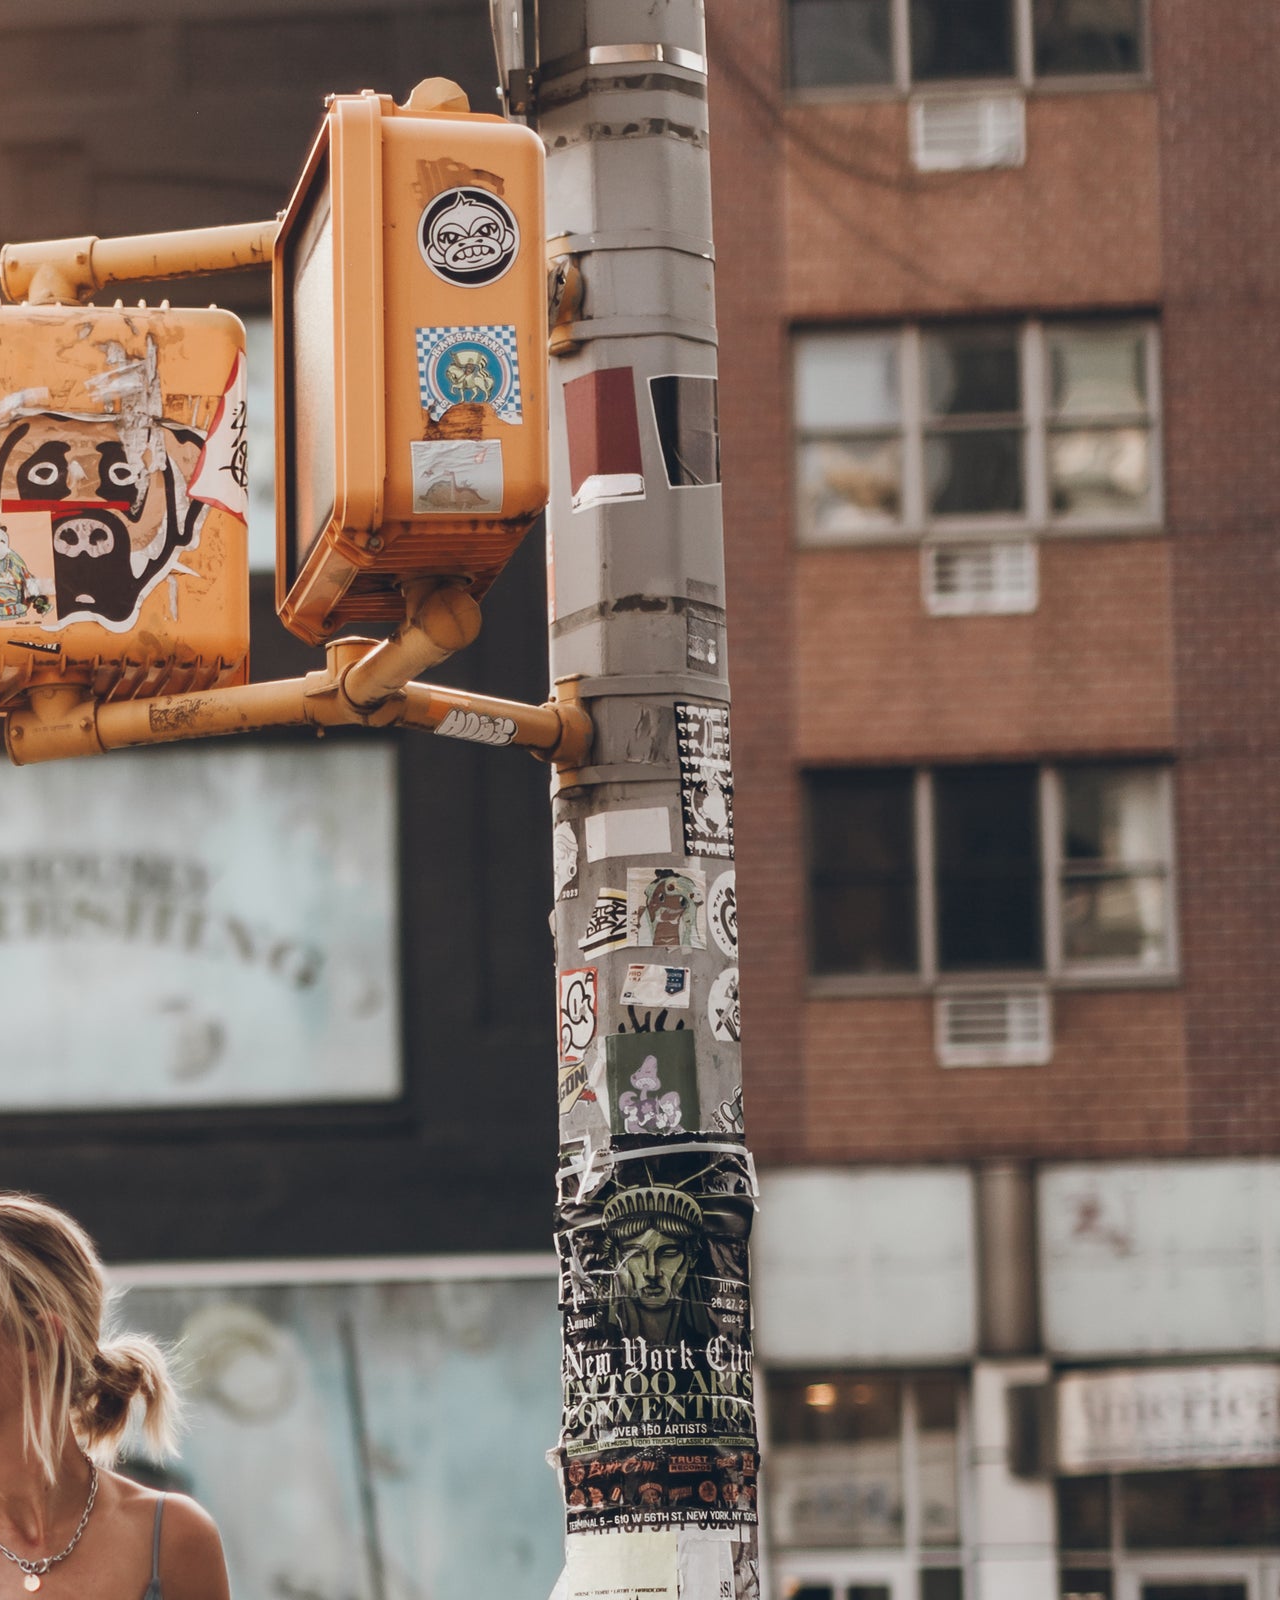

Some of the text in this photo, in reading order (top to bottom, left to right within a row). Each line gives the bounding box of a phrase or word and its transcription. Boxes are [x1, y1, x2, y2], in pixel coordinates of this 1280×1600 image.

[718, 1282, 738, 1293] JULY
[722, 1314, 741, 1324] 2024
[564, 1341, 613, 1381] New
[621, 1335, 696, 1378] York
[688, 1370, 754, 1396] ARTS
[613, 1423, 708, 1437] OVER 150 ARTISTS
[569, 1518, 597, 1530] TERMINAL
[599, 1517, 605, 1526] 5
[631, 1513, 642, 1523] W
[644, 1512, 669, 1522] 56TH
[687, 1511, 708, 1521] NEW
[732, 1512, 742, 1521] NY
